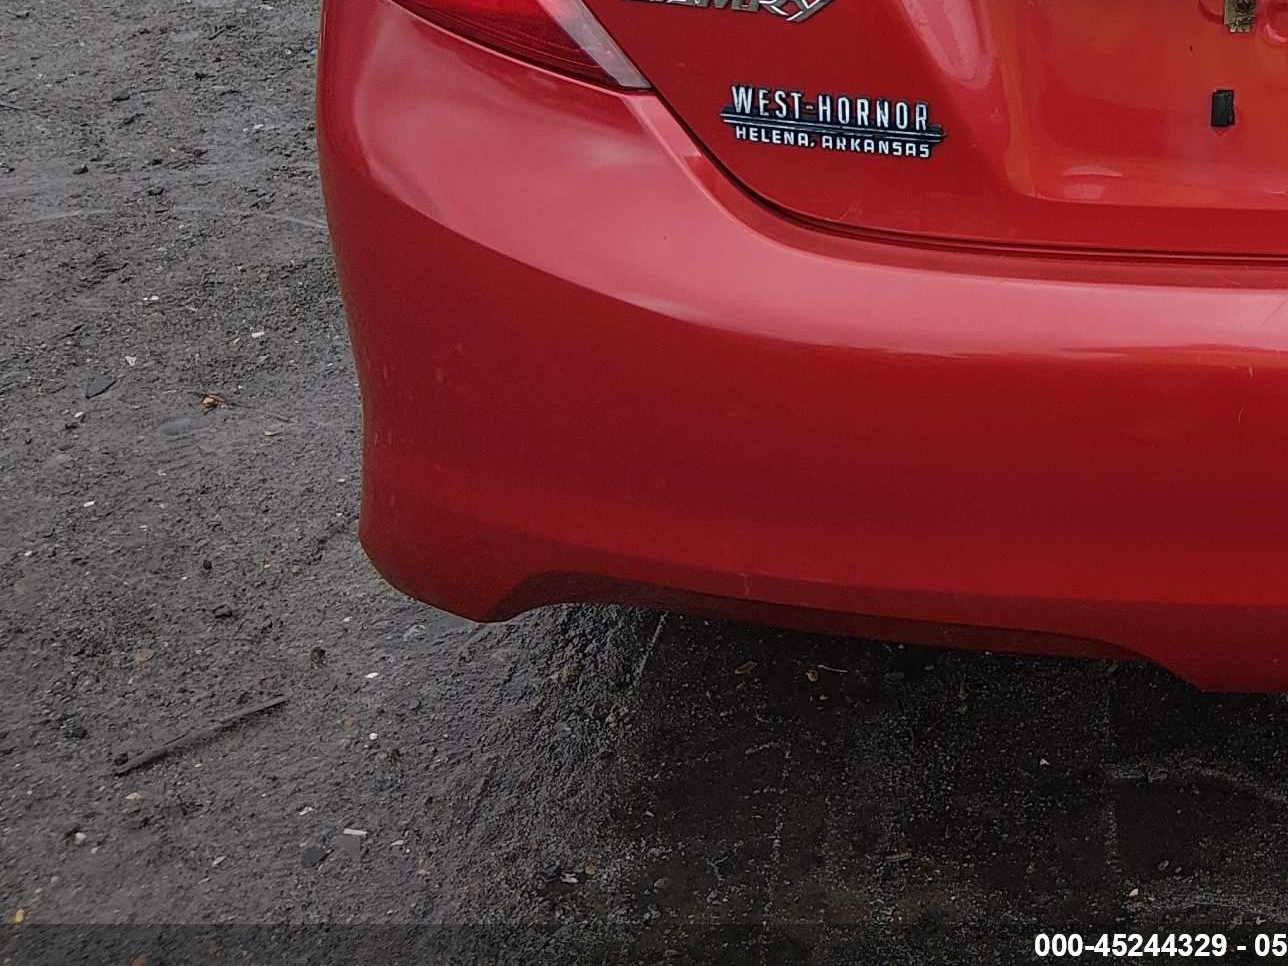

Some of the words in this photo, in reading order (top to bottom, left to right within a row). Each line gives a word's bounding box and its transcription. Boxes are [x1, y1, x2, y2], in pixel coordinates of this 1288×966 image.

[730, 85, 930, 131] WEST-HORNOR
[735, 125, 817, 149] HELENA,
[821, 136, 931, 159] ARKANSAS
